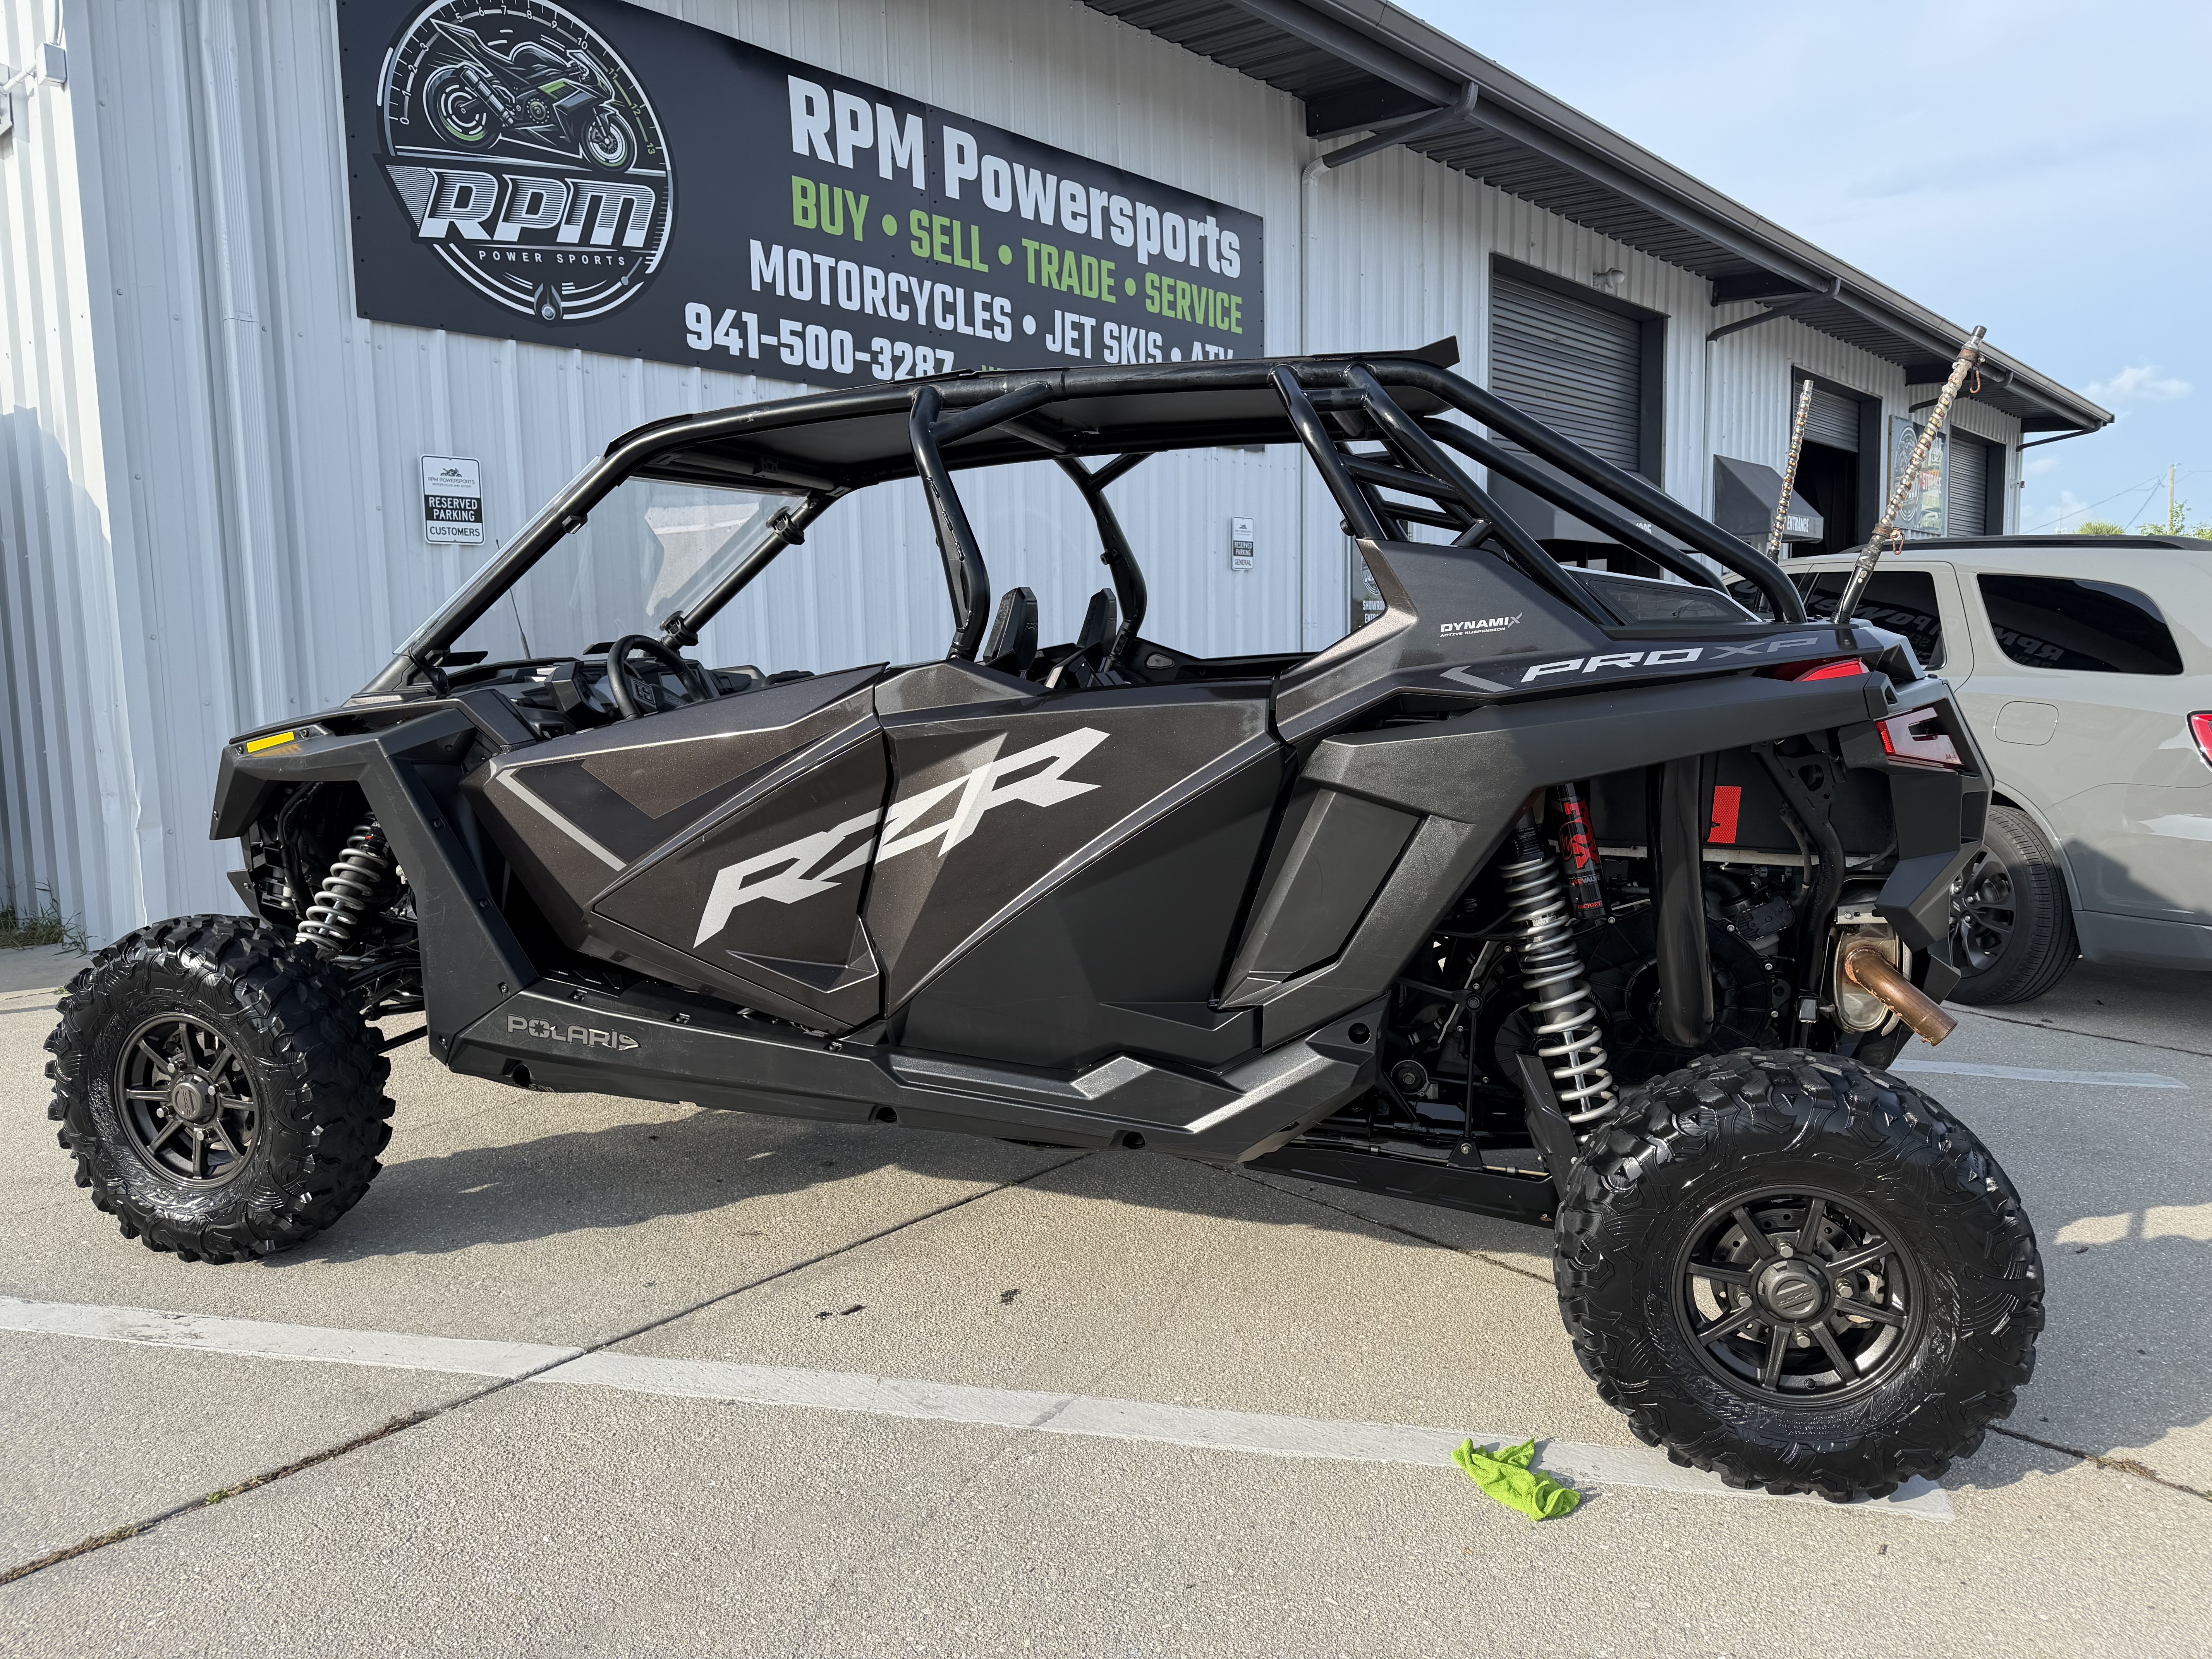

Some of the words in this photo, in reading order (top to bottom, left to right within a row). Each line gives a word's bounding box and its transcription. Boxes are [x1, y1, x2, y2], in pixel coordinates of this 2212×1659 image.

[409, 64, 419, 74] 2
[420, 42, 429, 52] 3
[456, 12, 463, 23] 5
[479, 6, 485, 17] 6
[501, 5, 508, 15] 7
[527, 9, 533, 20] 8
[551, 19, 558, 29] 9
[577, 37, 588, 50] 10
[608, 67, 618, 80] 11
[631, 103, 641, 117] 12
[646, 142, 656, 155] 13
[788, 75, 925, 190] RPM
[943, 125, 1240, 278] Powersports
[419, 167, 656, 248] RPM
[479, 250, 543, 263] POWER
[556, 253, 626, 266] SPORTS
[793, 177, 868, 240] BUY
[911, 211, 988, 271] SELL
[1023, 240, 1118, 302] TRADE
[1147, 273, 1242, 333] SERVICE
[750, 239, 1012, 342] MOTORCYCLES
[1046, 310, 1096, 359] JET
[1104, 322, 1163, 364] SKIS
[685, 302, 954, 380] 941-500-3287
[429, 497, 477, 510] RESERVED
[433, 509, 475, 522] PARKING
[1787, 515, 1809, 533] ENTRANCE
[430, 526, 480, 536] CUSTOMERS
[1234, 541, 1252, 549] RESERVED
[1441, 612, 1523, 632] DYNAMIX
[1520, 647, 1705, 683] PRO
[1708, 637, 1818, 660] XP
[693, 726, 1111, 949] RZR
[507, 1013, 641, 1051] POLARIS
